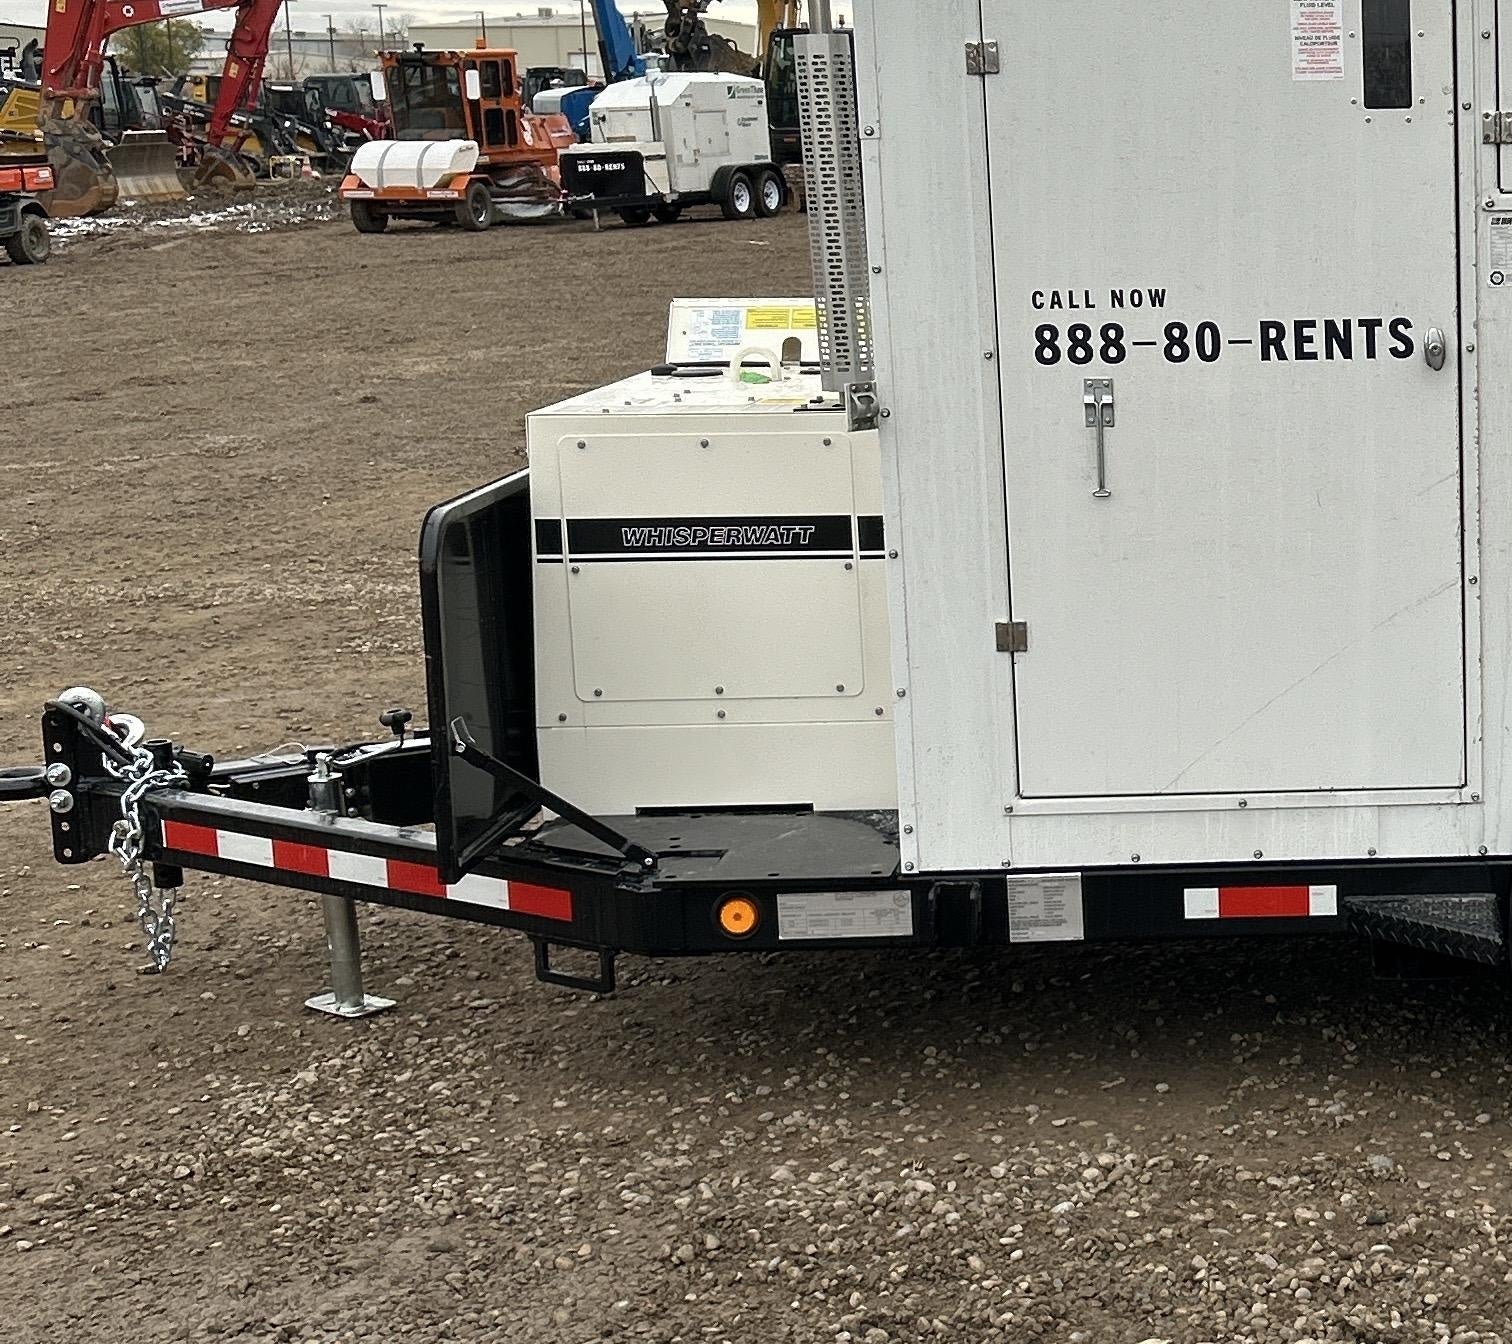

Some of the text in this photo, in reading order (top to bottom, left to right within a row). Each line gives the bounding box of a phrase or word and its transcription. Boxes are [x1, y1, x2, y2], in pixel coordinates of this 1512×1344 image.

[1031, 288, 1167, 310] CALL NOW
[1034, 317, 1415, 366] 888-80-RENTS
[621, 525, 815, 547] WHISPERWATT
